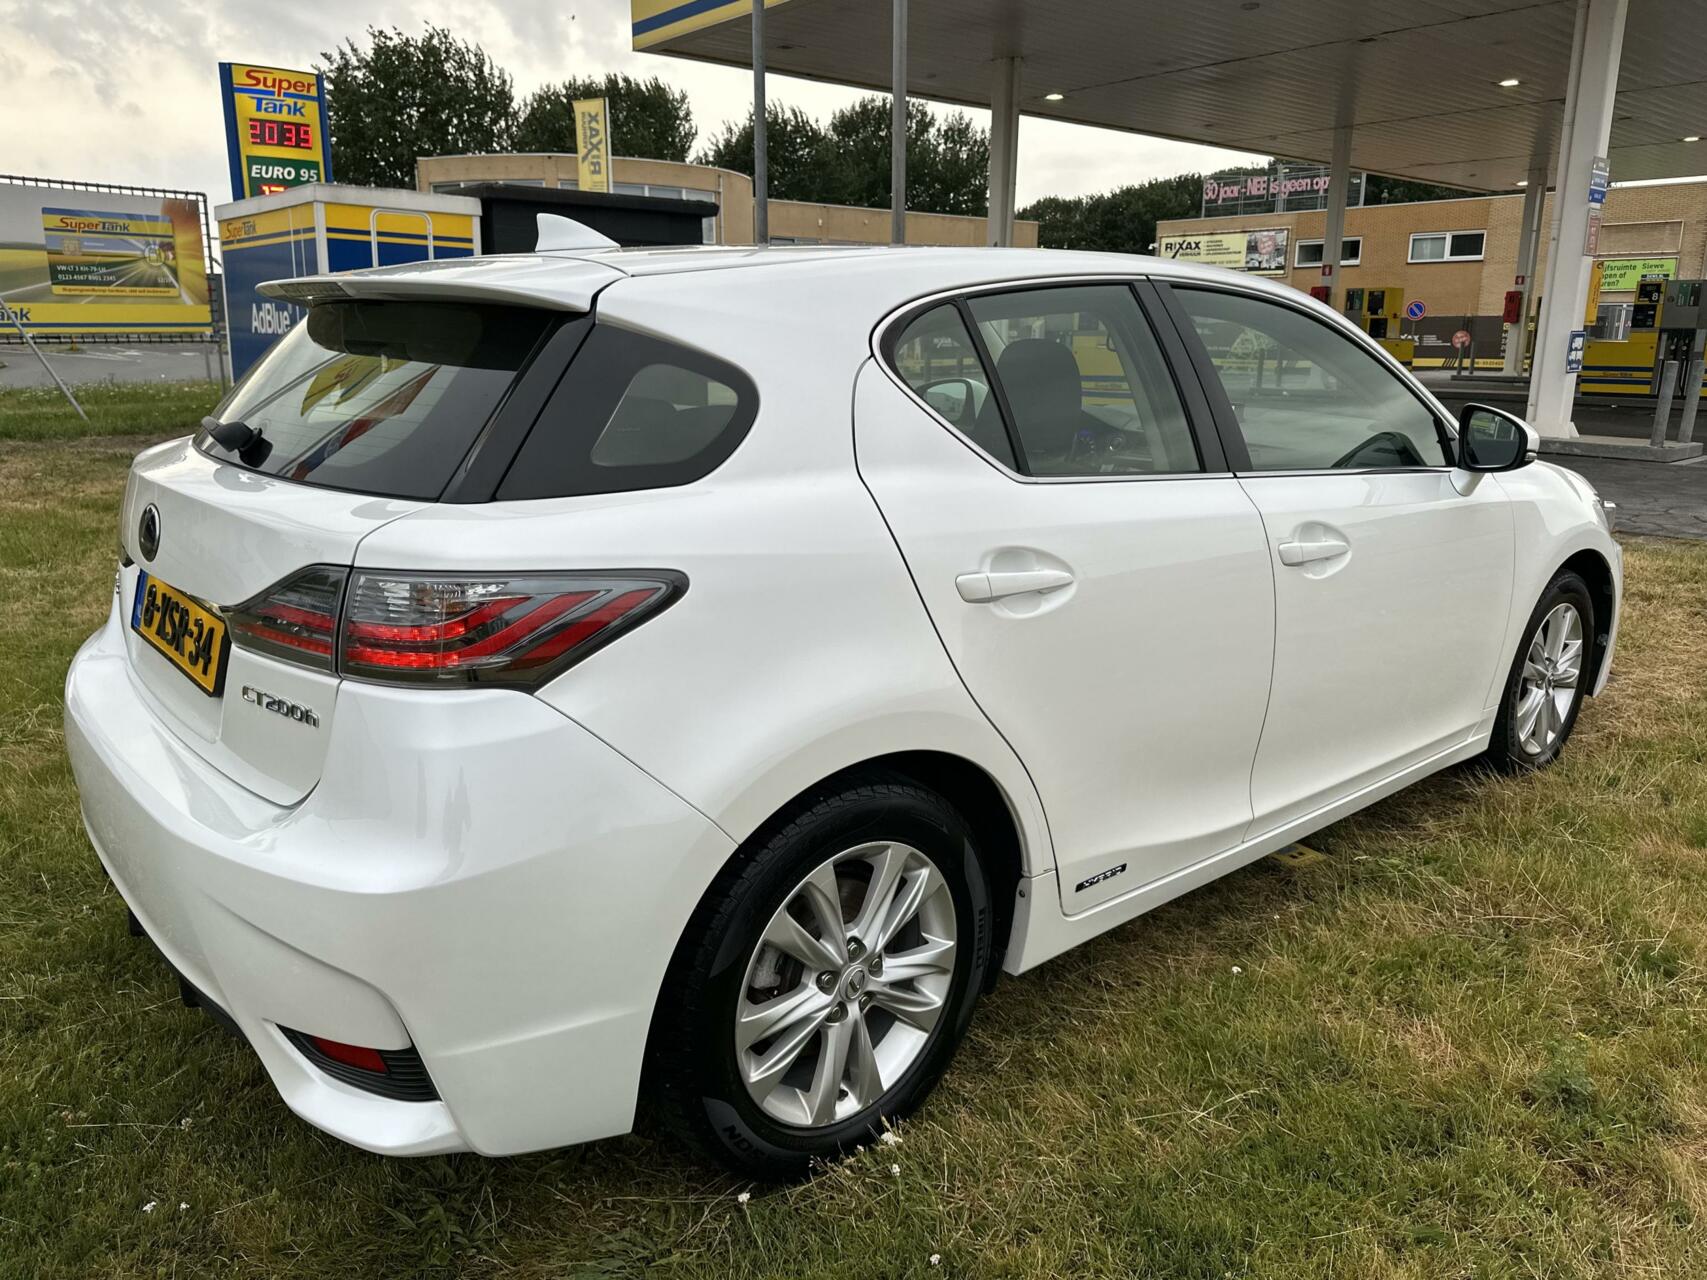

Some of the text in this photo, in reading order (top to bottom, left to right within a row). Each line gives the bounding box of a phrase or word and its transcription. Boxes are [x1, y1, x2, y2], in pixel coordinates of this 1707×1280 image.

[233, 69, 315, 97] Super
[248, 96, 305, 117] Tank
[249, 120, 313, 147] 2039
[251, 165, 318, 181] EURO 95
[1204, 180, 1218, 200] 30
[1218, 183, 1239, 204] jaar
[1246, 177, 1267, 195] NEE
[1269, 179, 1280, 194] is
[1281, 178, 1310, 197] geen
[1313, 176, 1330, 195] op
[1165, 240, 1201, 259] RIXAX
[242, 686, 320, 729] CT200h
